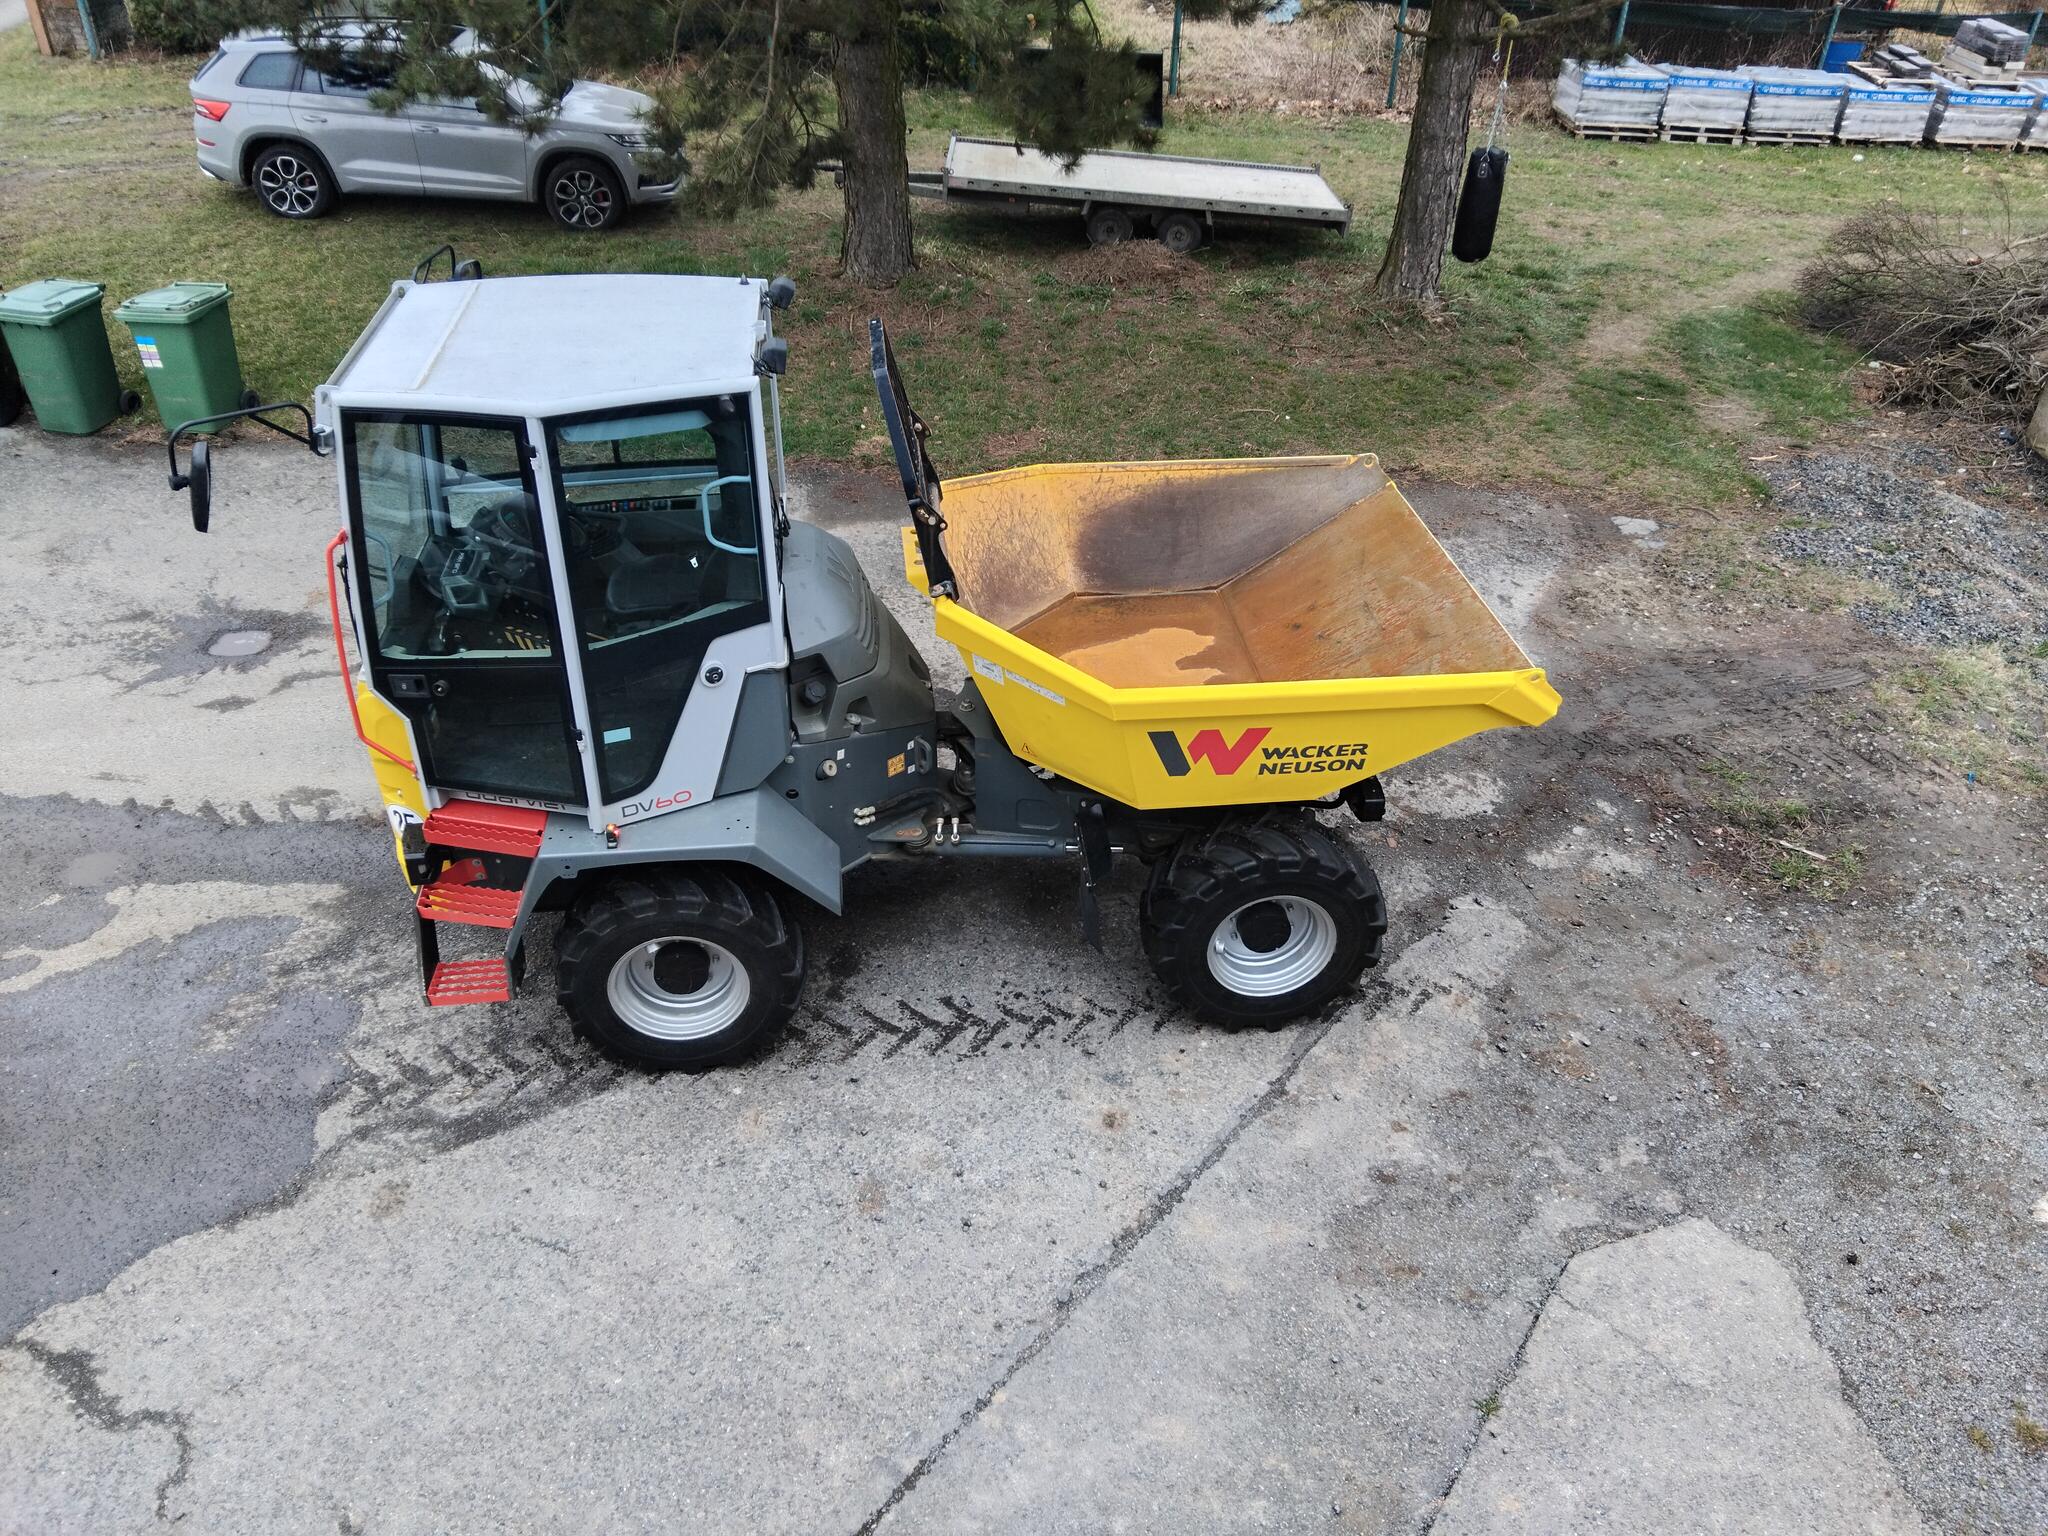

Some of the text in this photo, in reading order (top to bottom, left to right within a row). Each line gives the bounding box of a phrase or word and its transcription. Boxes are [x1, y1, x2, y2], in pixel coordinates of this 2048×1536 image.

[1261, 743, 1369, 760] WACKER
[1258, 758, 1366, 775] NEUSON
[621, 790, 692, 818] DV60
